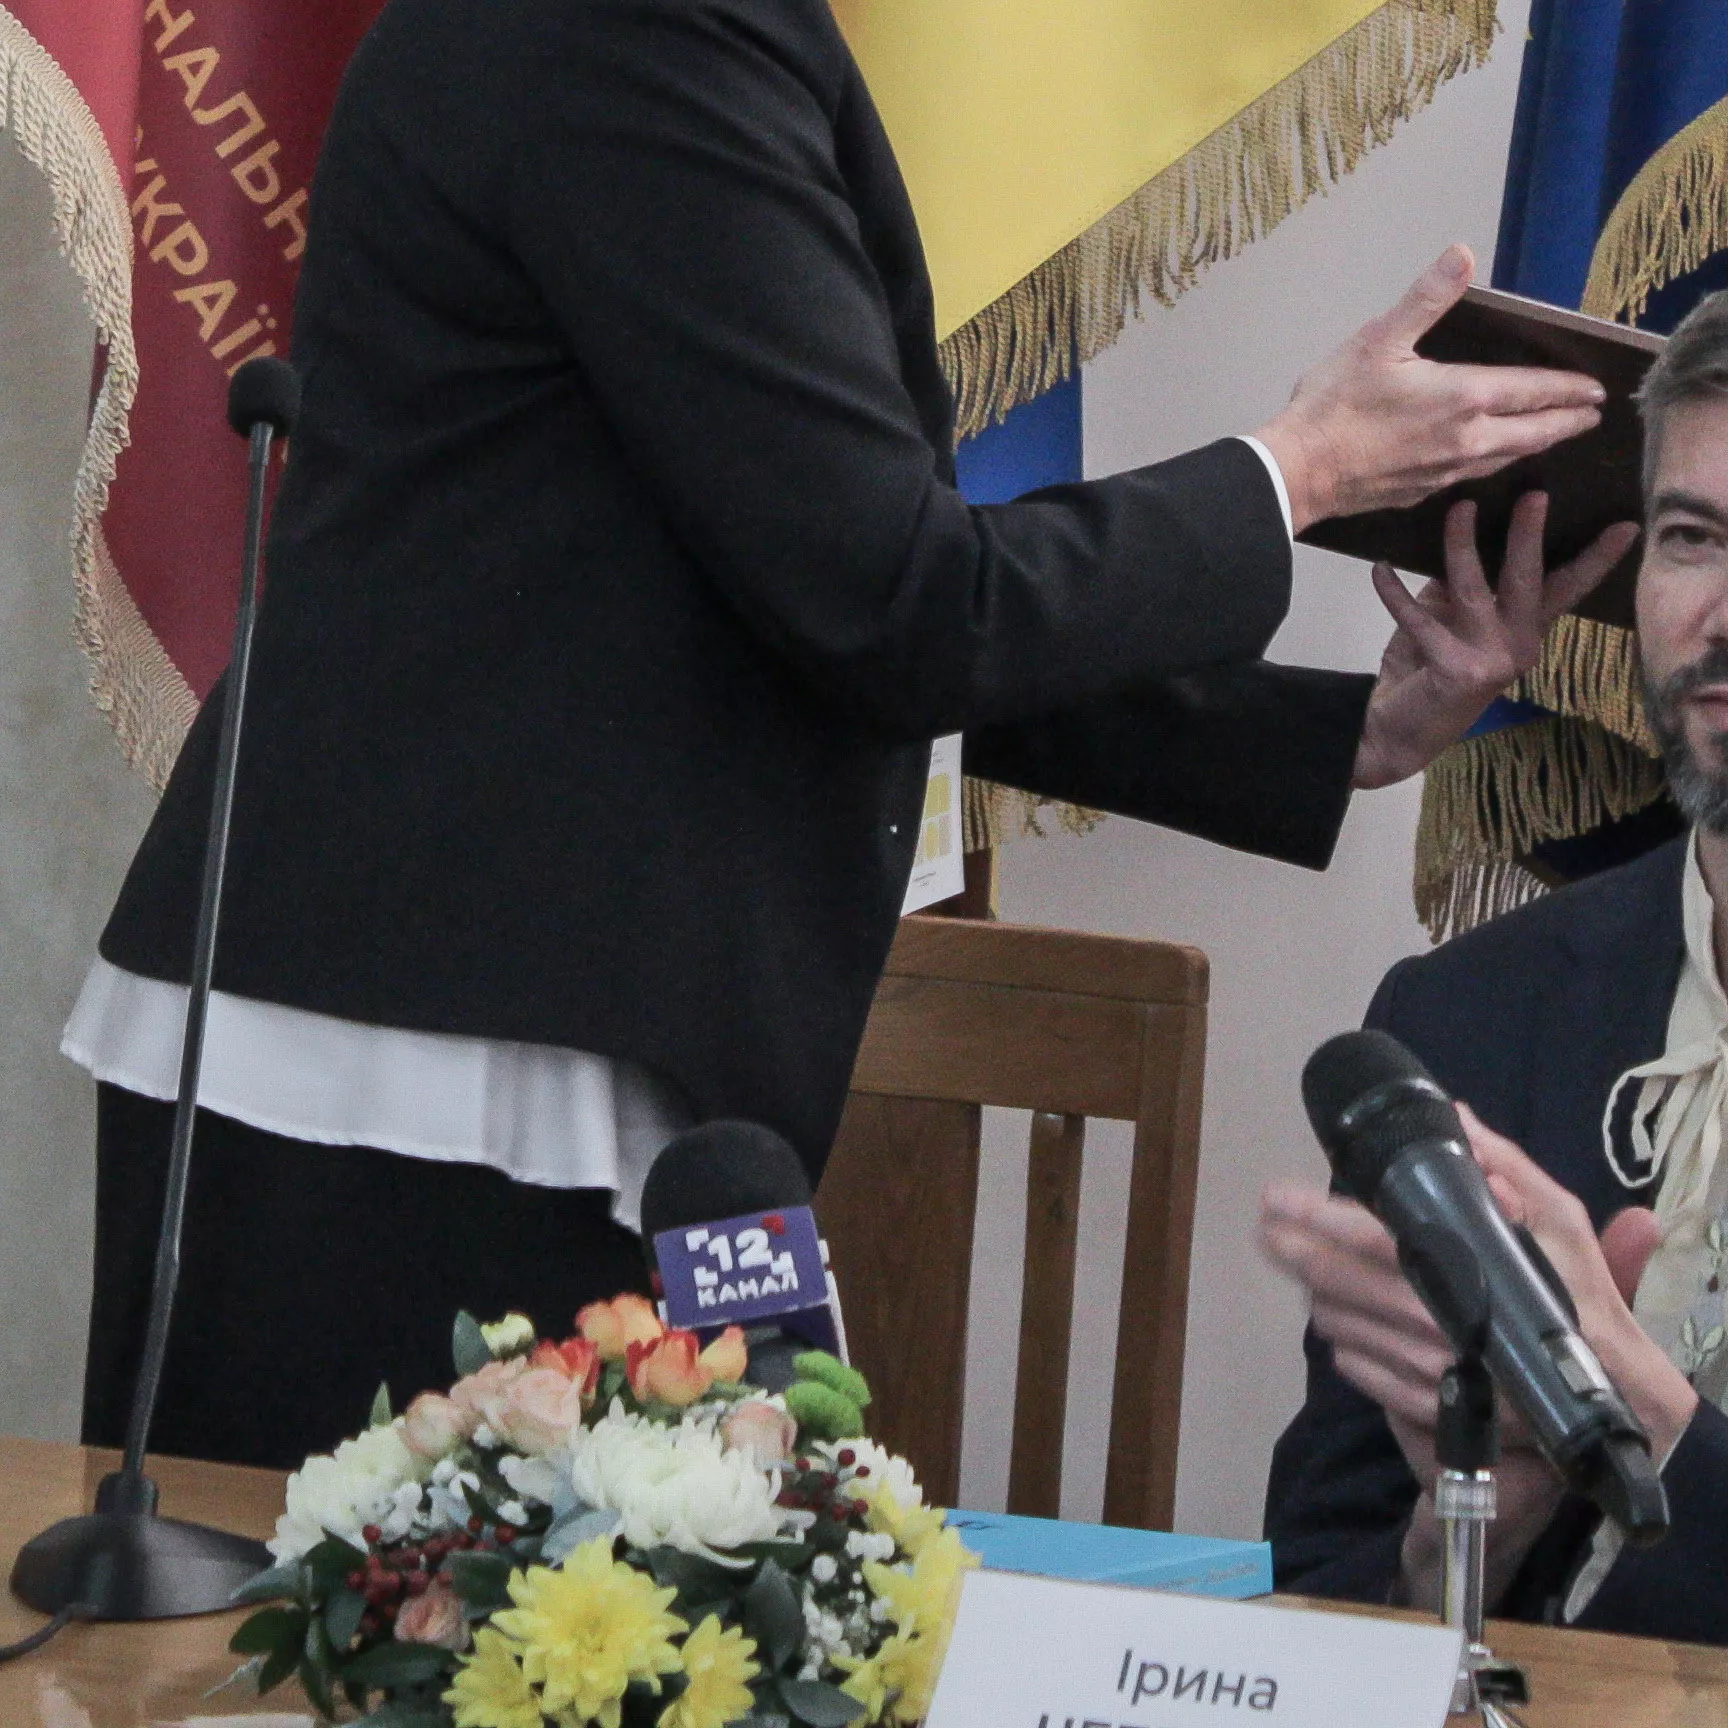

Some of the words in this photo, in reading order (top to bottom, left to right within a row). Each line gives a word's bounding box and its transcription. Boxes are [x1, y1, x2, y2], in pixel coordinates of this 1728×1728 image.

[130, 125, 277, 378] КРАЇ
[707, 1227, 773, 1273] 12
[697, 1270, 799, 1309] КАНАЛ
[1116, 1647, 1280, 1712] Ірина
